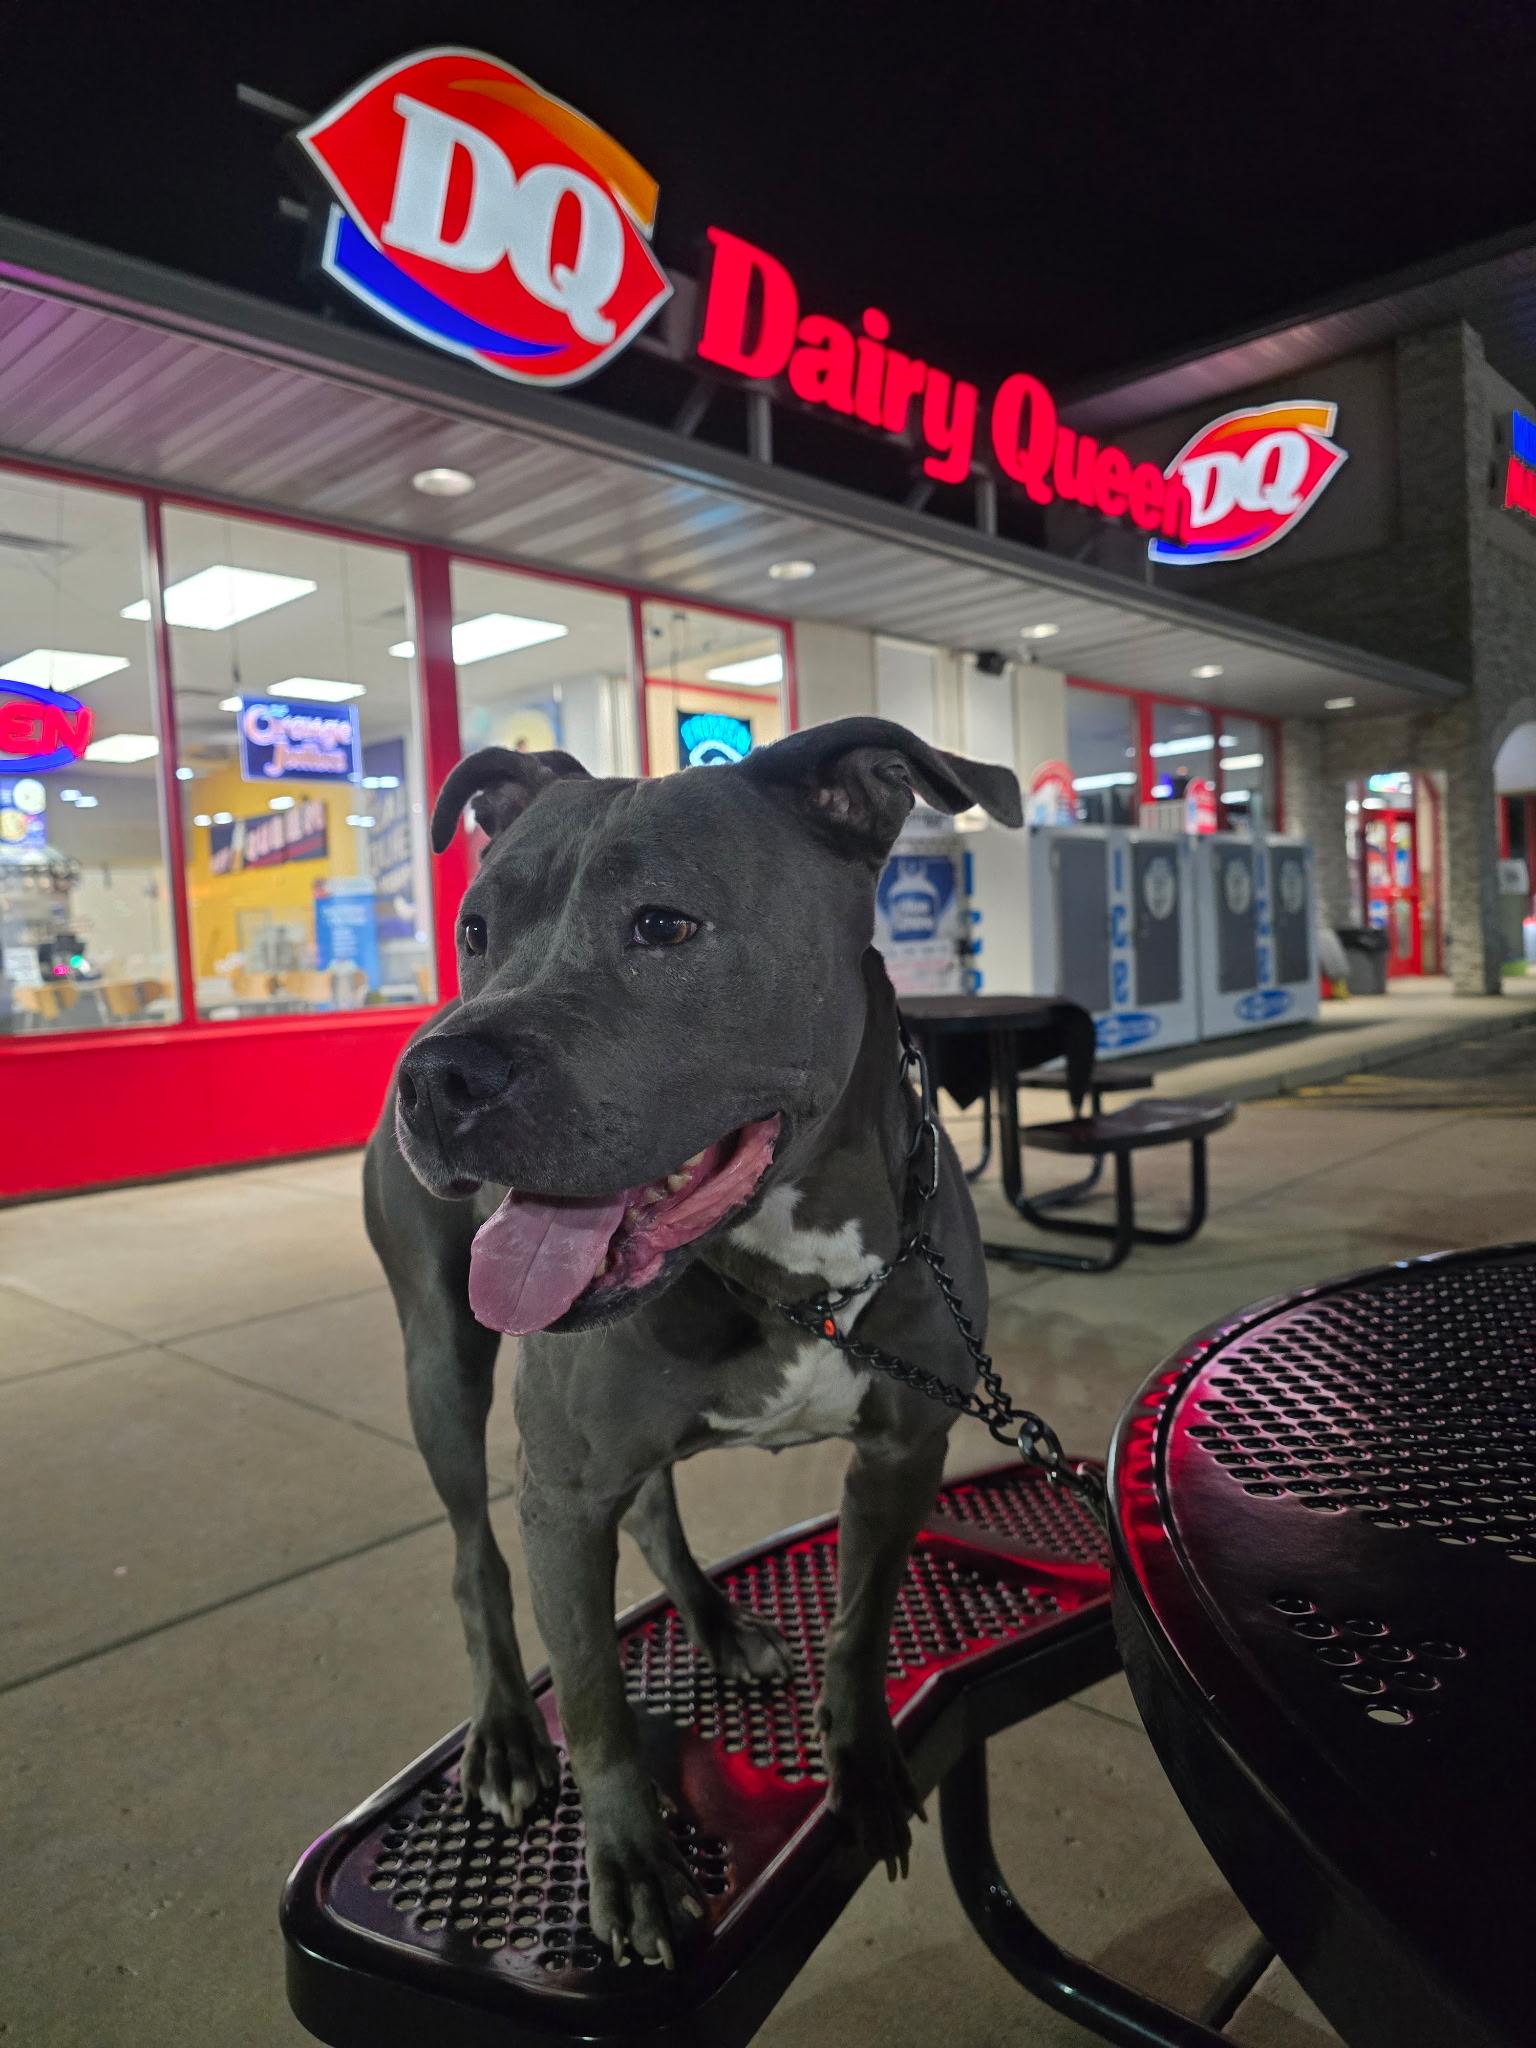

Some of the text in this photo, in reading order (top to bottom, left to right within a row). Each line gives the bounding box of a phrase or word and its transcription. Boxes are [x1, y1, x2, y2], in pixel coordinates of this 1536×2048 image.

[383, 94, 626, 347] DQ
[697, 226, 1189, 545] Dairy Queen
[1180, 430, 1311, 529] DQ
